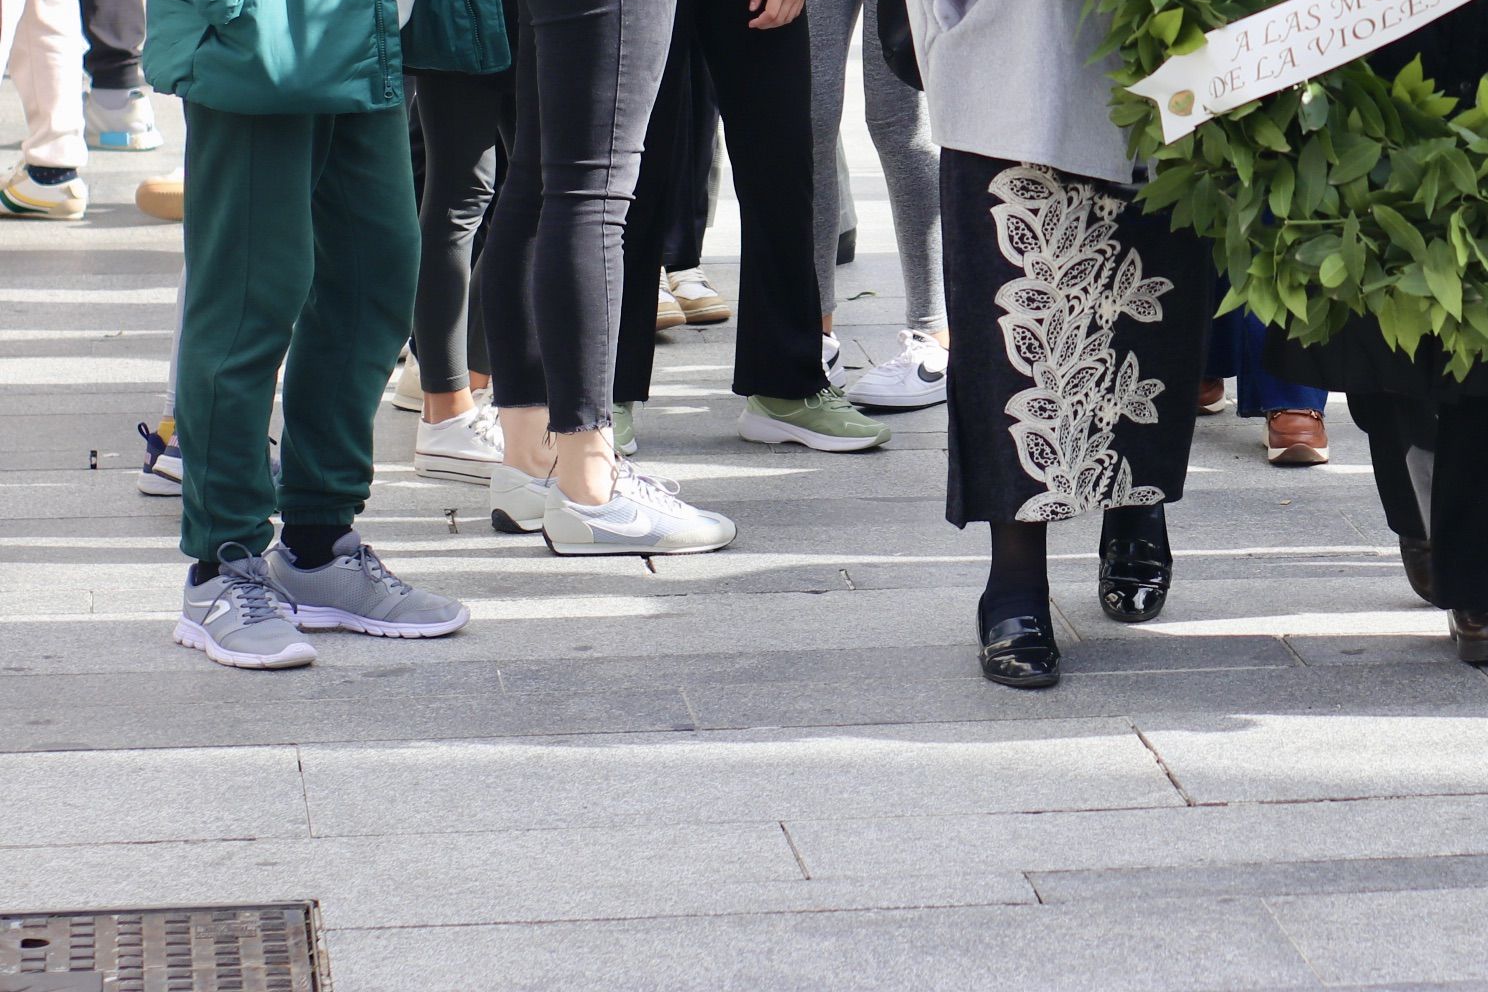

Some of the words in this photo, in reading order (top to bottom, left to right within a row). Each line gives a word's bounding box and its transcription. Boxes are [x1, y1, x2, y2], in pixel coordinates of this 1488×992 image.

[1231, 30, 1254, 62] A
[1263, 3, 1322, 46] LAS
[1208, 65, 1247, 100] DE
[1255, 45, 1298, 83] LA
